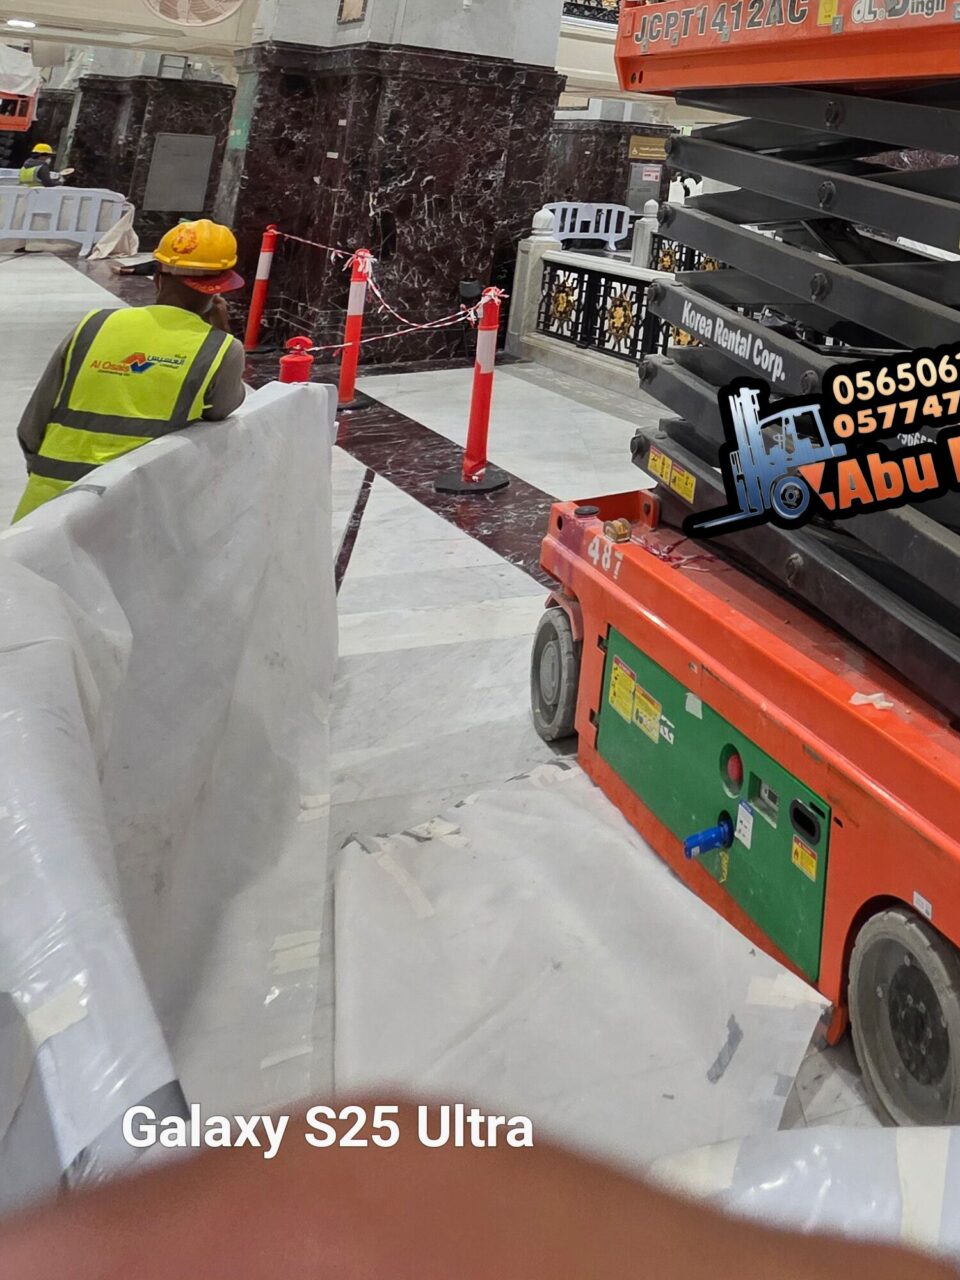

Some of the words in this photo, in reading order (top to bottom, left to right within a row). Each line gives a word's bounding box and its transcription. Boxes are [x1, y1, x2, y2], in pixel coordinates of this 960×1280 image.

[681, 299, 713, 339] Korea
[713, 317, 752, 360] Rental
[752, 337, 786, 383] Corp.
